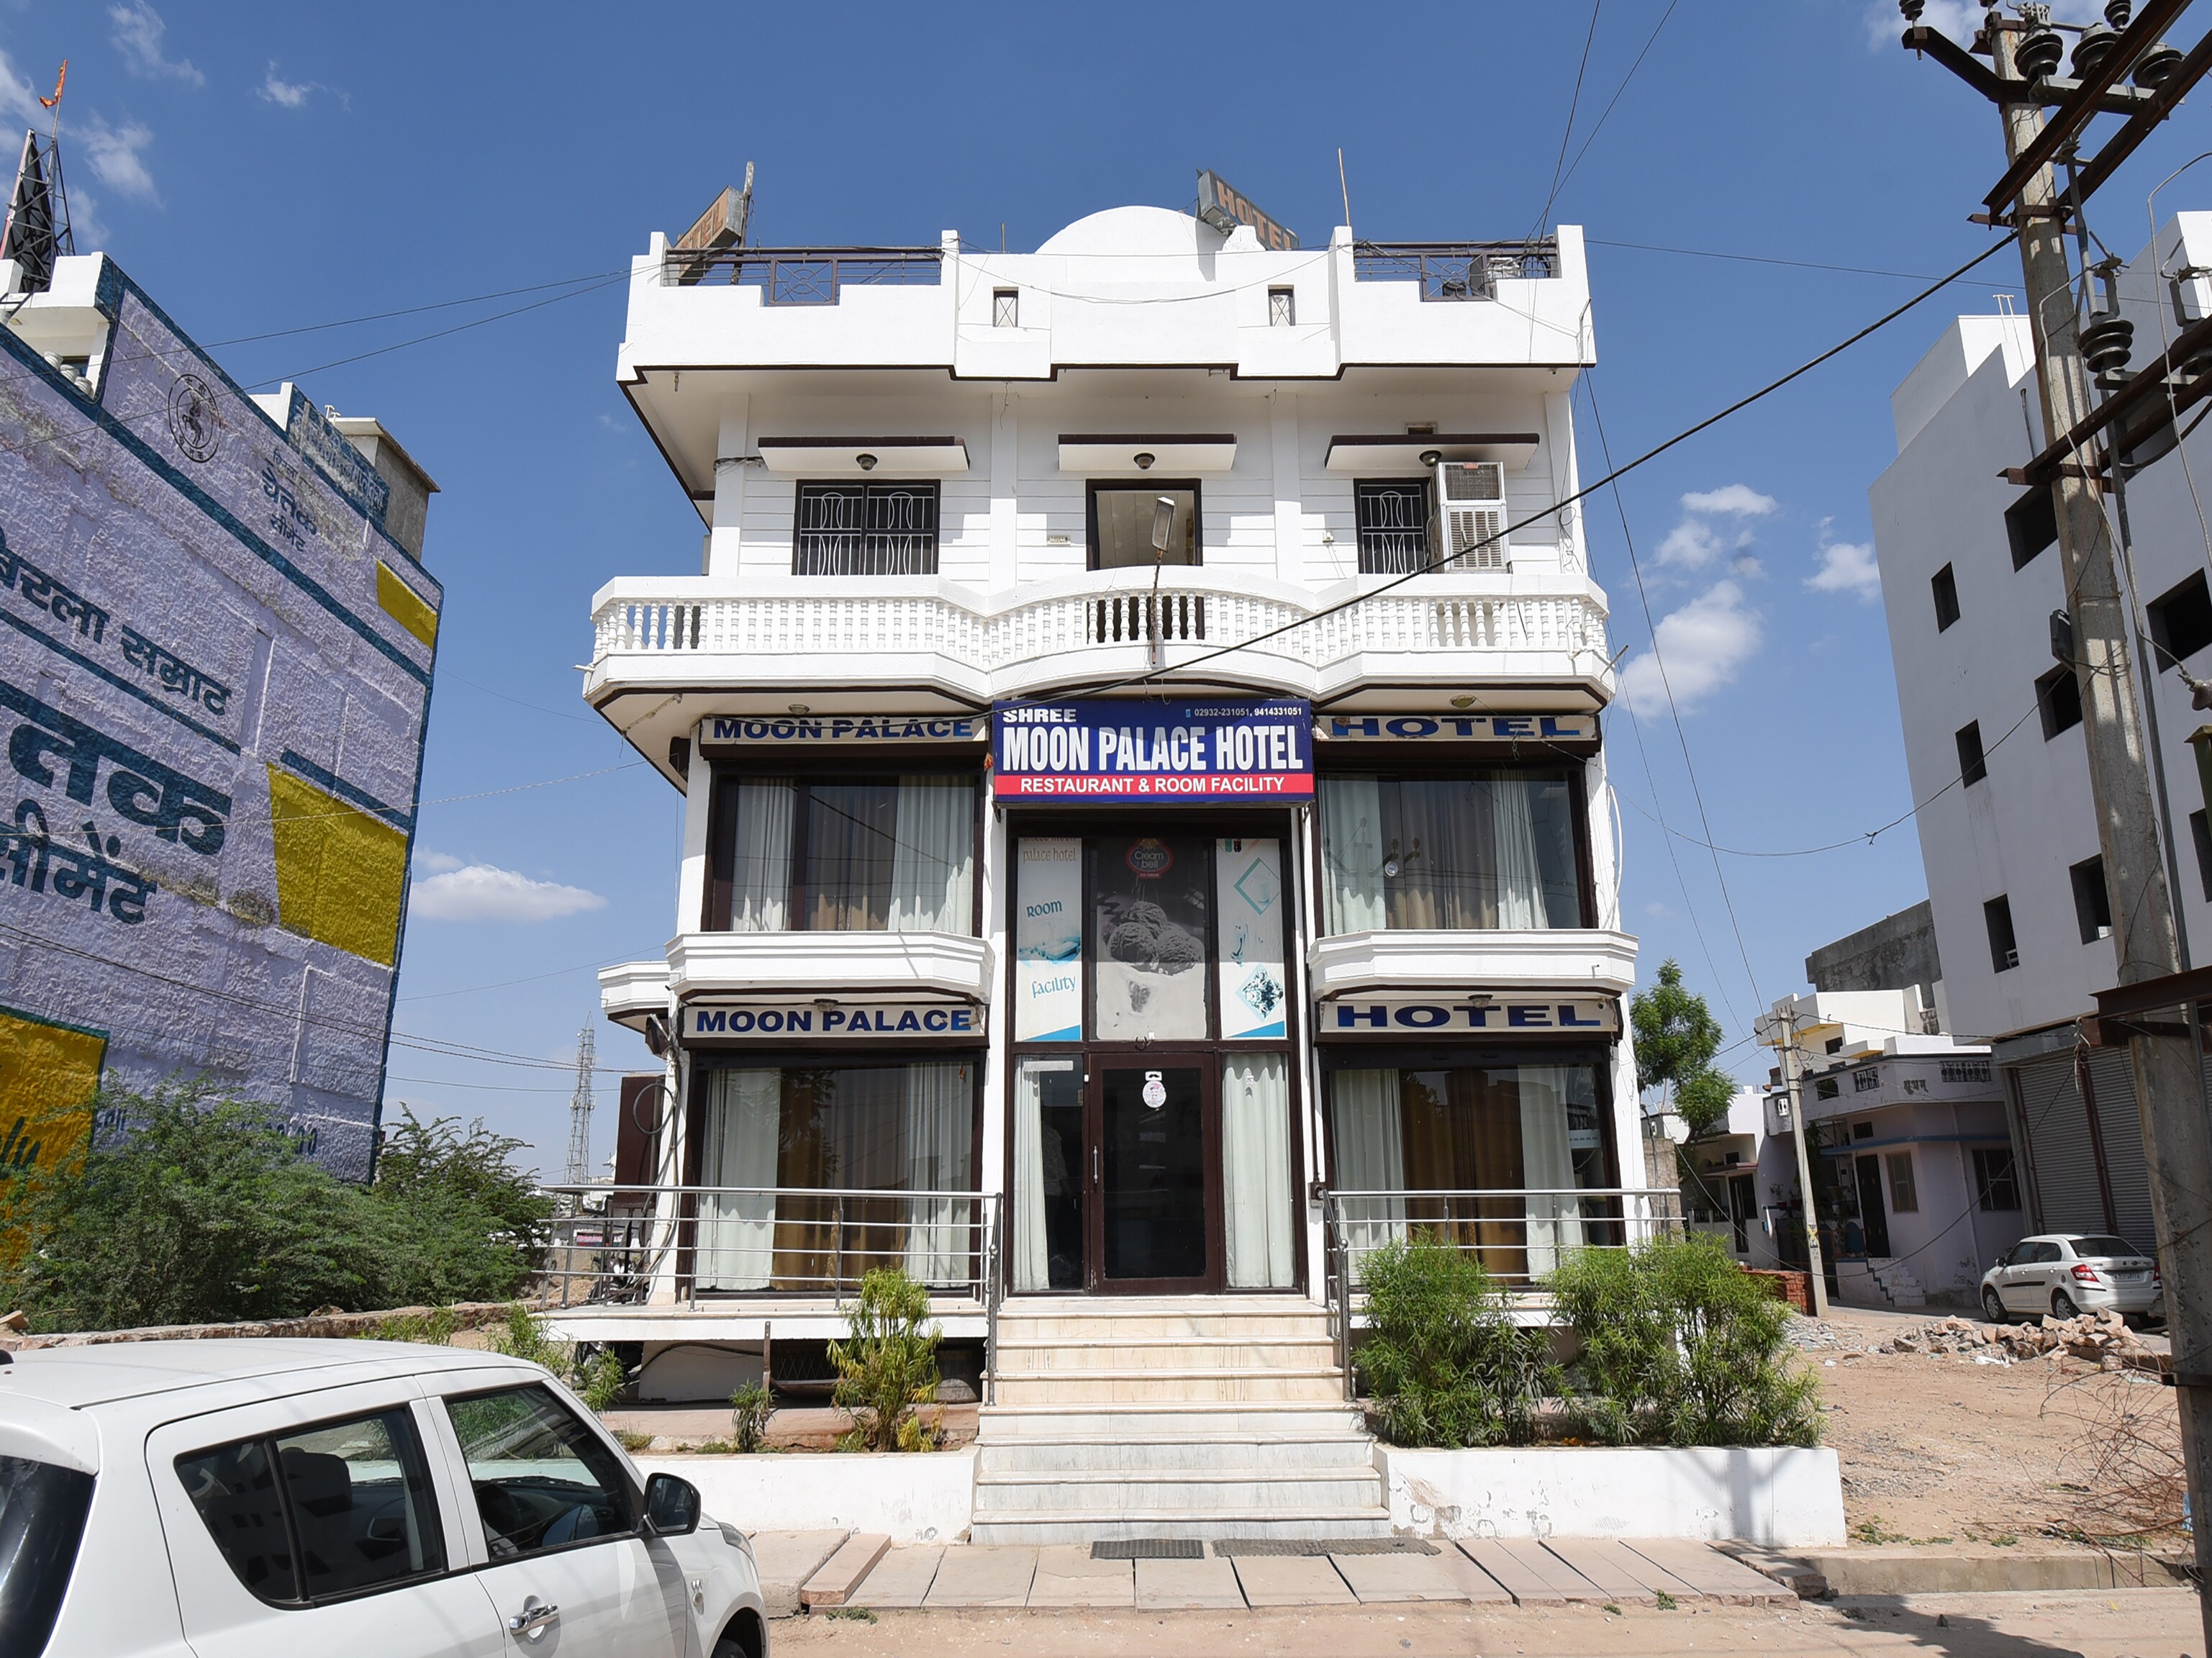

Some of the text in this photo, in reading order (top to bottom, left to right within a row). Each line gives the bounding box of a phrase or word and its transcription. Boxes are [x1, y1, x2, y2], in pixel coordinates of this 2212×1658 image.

[120, 623, 232, 716] सम्राट
[1002, 708, 1076, 723] SHREE
[1194, 707, 1302, 717] 02932-231051, 9414331051
[713, 718, 973, 739] MOON PALACE
[1331, 717, 1581, 737] HOTEL
[1002, 725, 1303, 771] MOON PALACE HOTEL
[0, 680, 232, 856] तक
[1020, 776, 1284, 793] RESTAURANT & ROOM FACILITY
[1023, 848, 1076, 865] palace hotel
[1134, 851, 1164, 860] Cream
[1141, 860, 1159, 869] bell
[1032, 976, 1076, 999] facility
[696, 1010, 972, 1032] MOON PALACE
[1337, 1005, 1601, 1028] HOTEL
